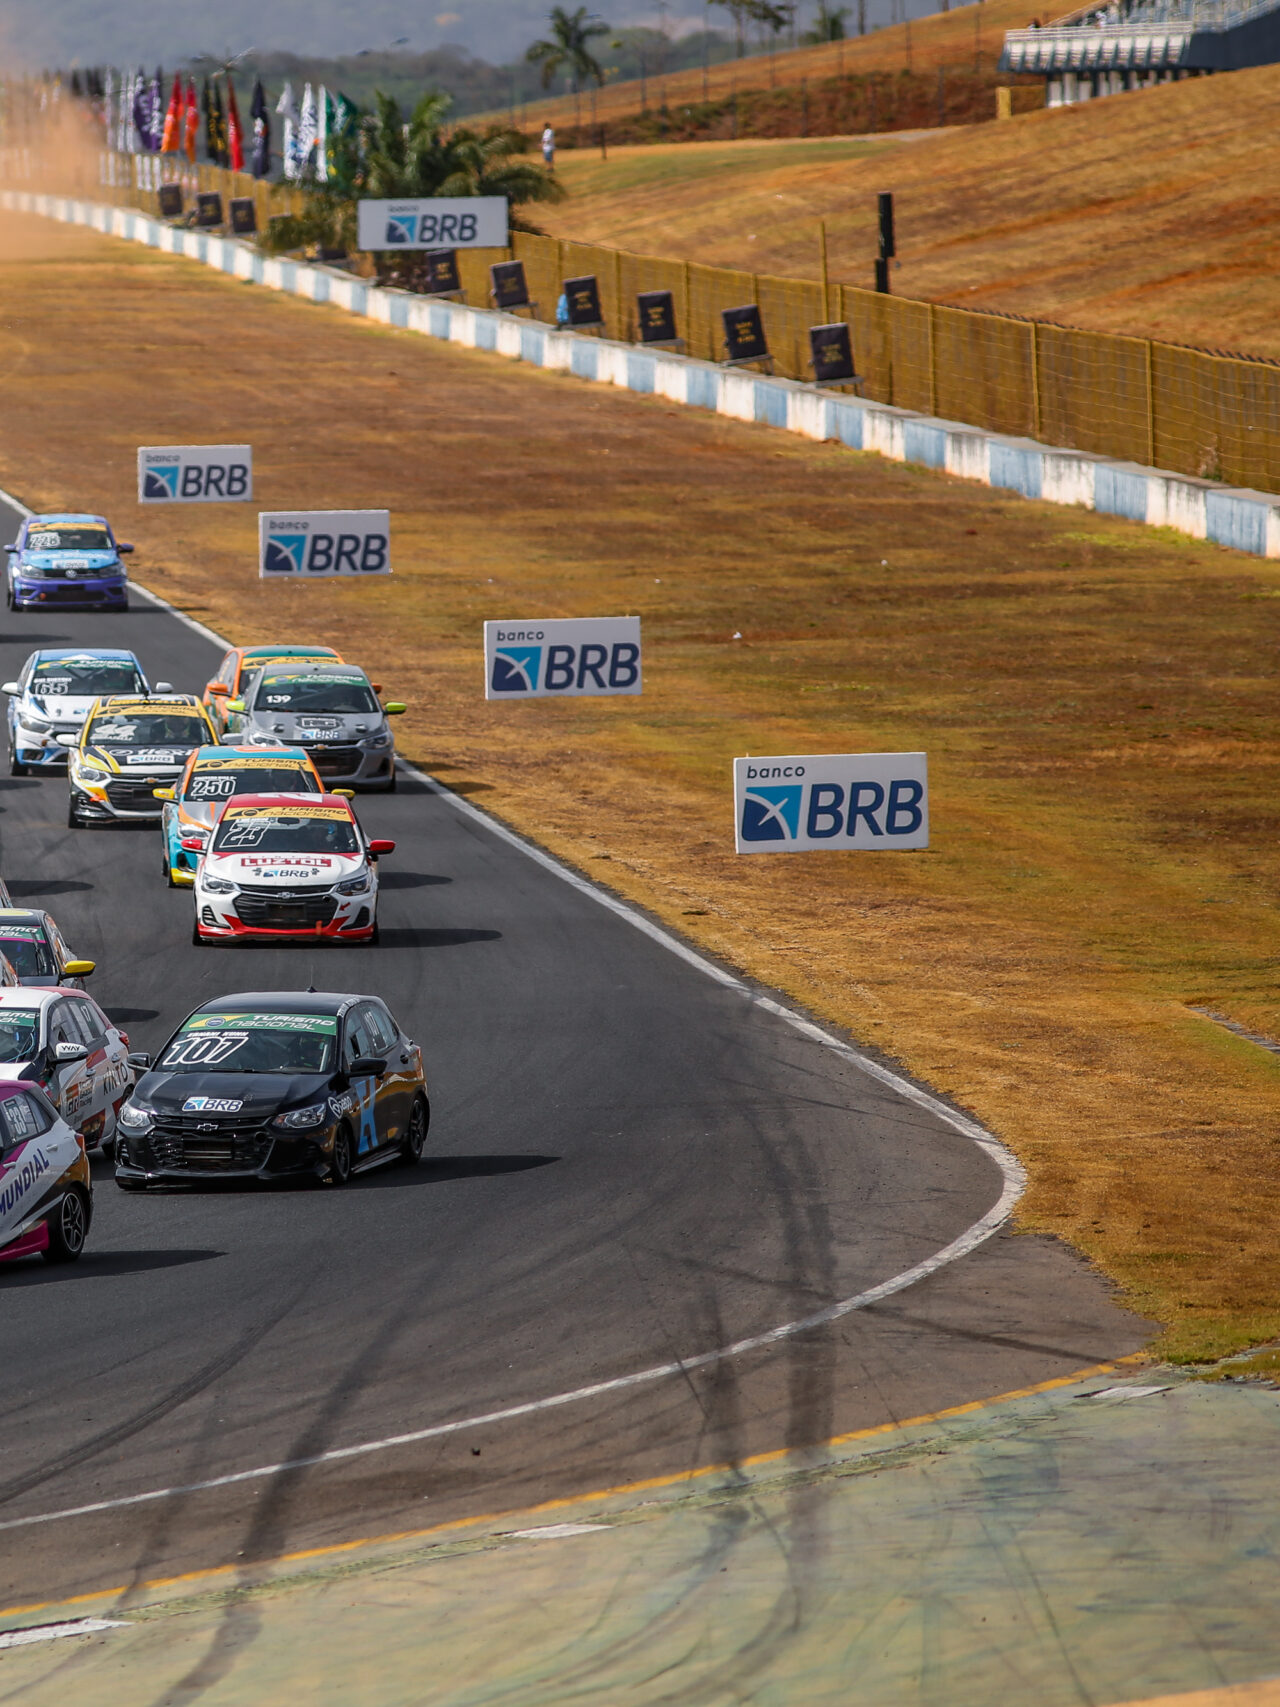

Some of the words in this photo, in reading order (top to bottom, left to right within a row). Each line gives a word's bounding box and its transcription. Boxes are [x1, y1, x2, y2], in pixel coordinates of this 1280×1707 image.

[419, 213, 478, 243] BRB
[181, 464, 248, 497] BRB
[269, 520, 309, 530] banco
[307, 534, 388, 572] BRB
[497, 630, 545, 641] banco
[544, 642, 640, 690] BRB
[266, 695, 292, 703] 139
[746, 765, 806, 779] banco
[191, 780, 236, 797] 250
[280, 807, 347, 815] TURISMO
[807, 779, 924, 839] BRB
[219, 818, 272, 849] 23
[244, 858, 330, 866] LUZTOL
[280, 870, 310, 878] BRB
[253, 1015, 335, 1026] TURISMO
[162, 1036, 250, 1066] 107
[203, 1100, 242, 1111] BRB
